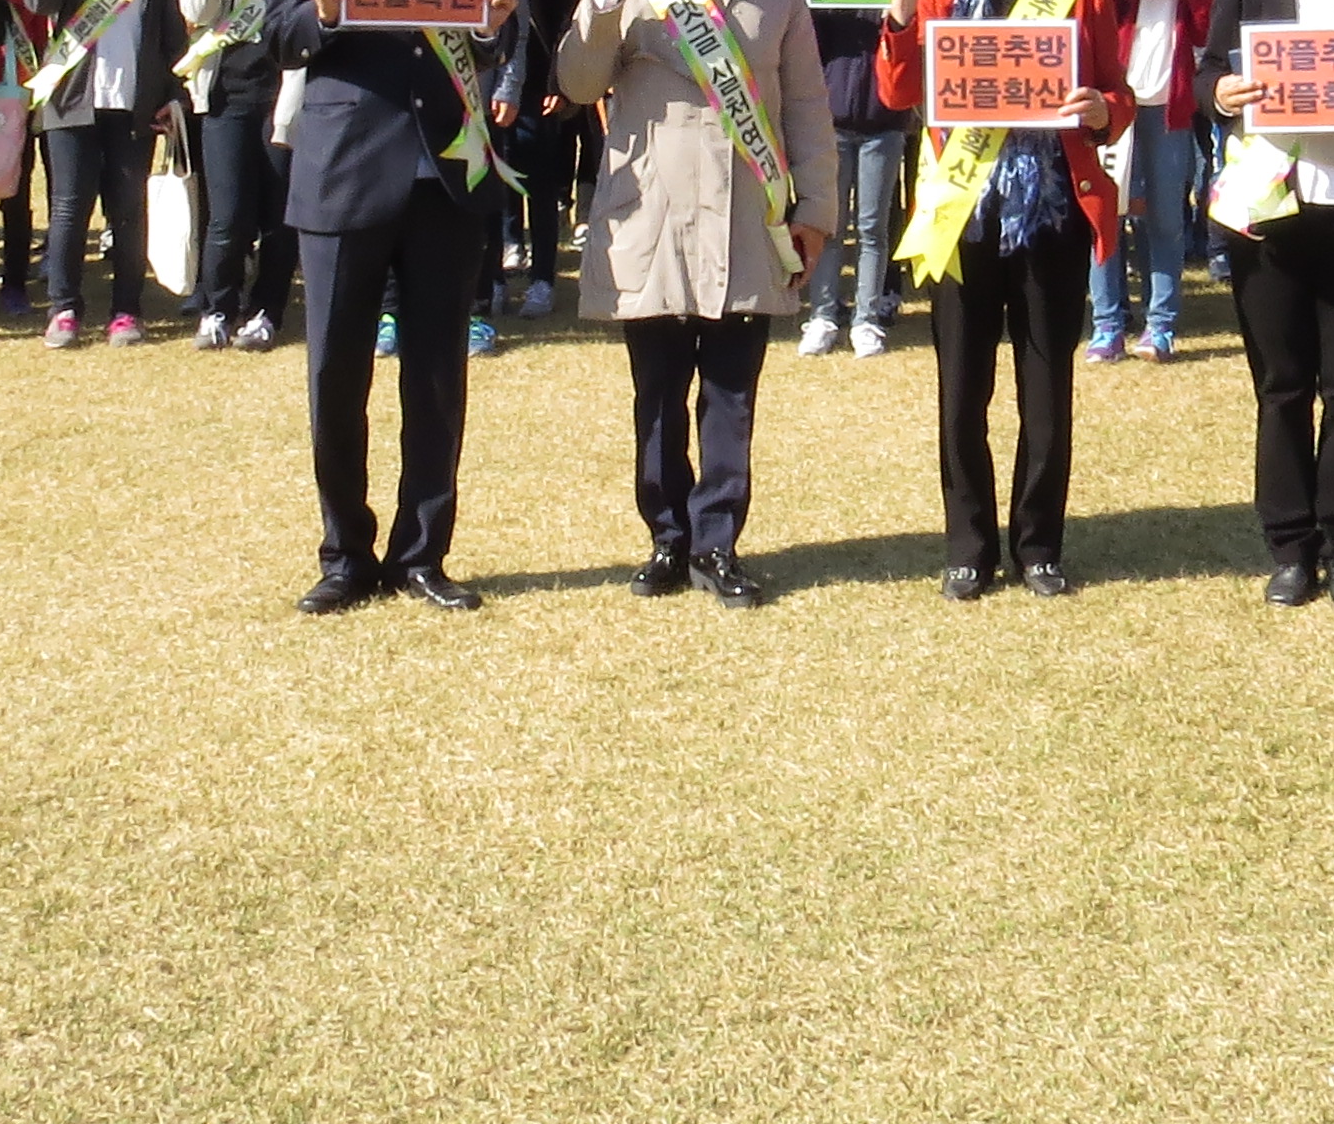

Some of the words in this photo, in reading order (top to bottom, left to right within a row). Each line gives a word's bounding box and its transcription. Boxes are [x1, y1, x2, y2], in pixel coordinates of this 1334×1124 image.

[937, 34, 1067, 68] 악플추방
[937, 77, 1067, 110] 선플확산
[708, 59, 781, 183] 실천연대
